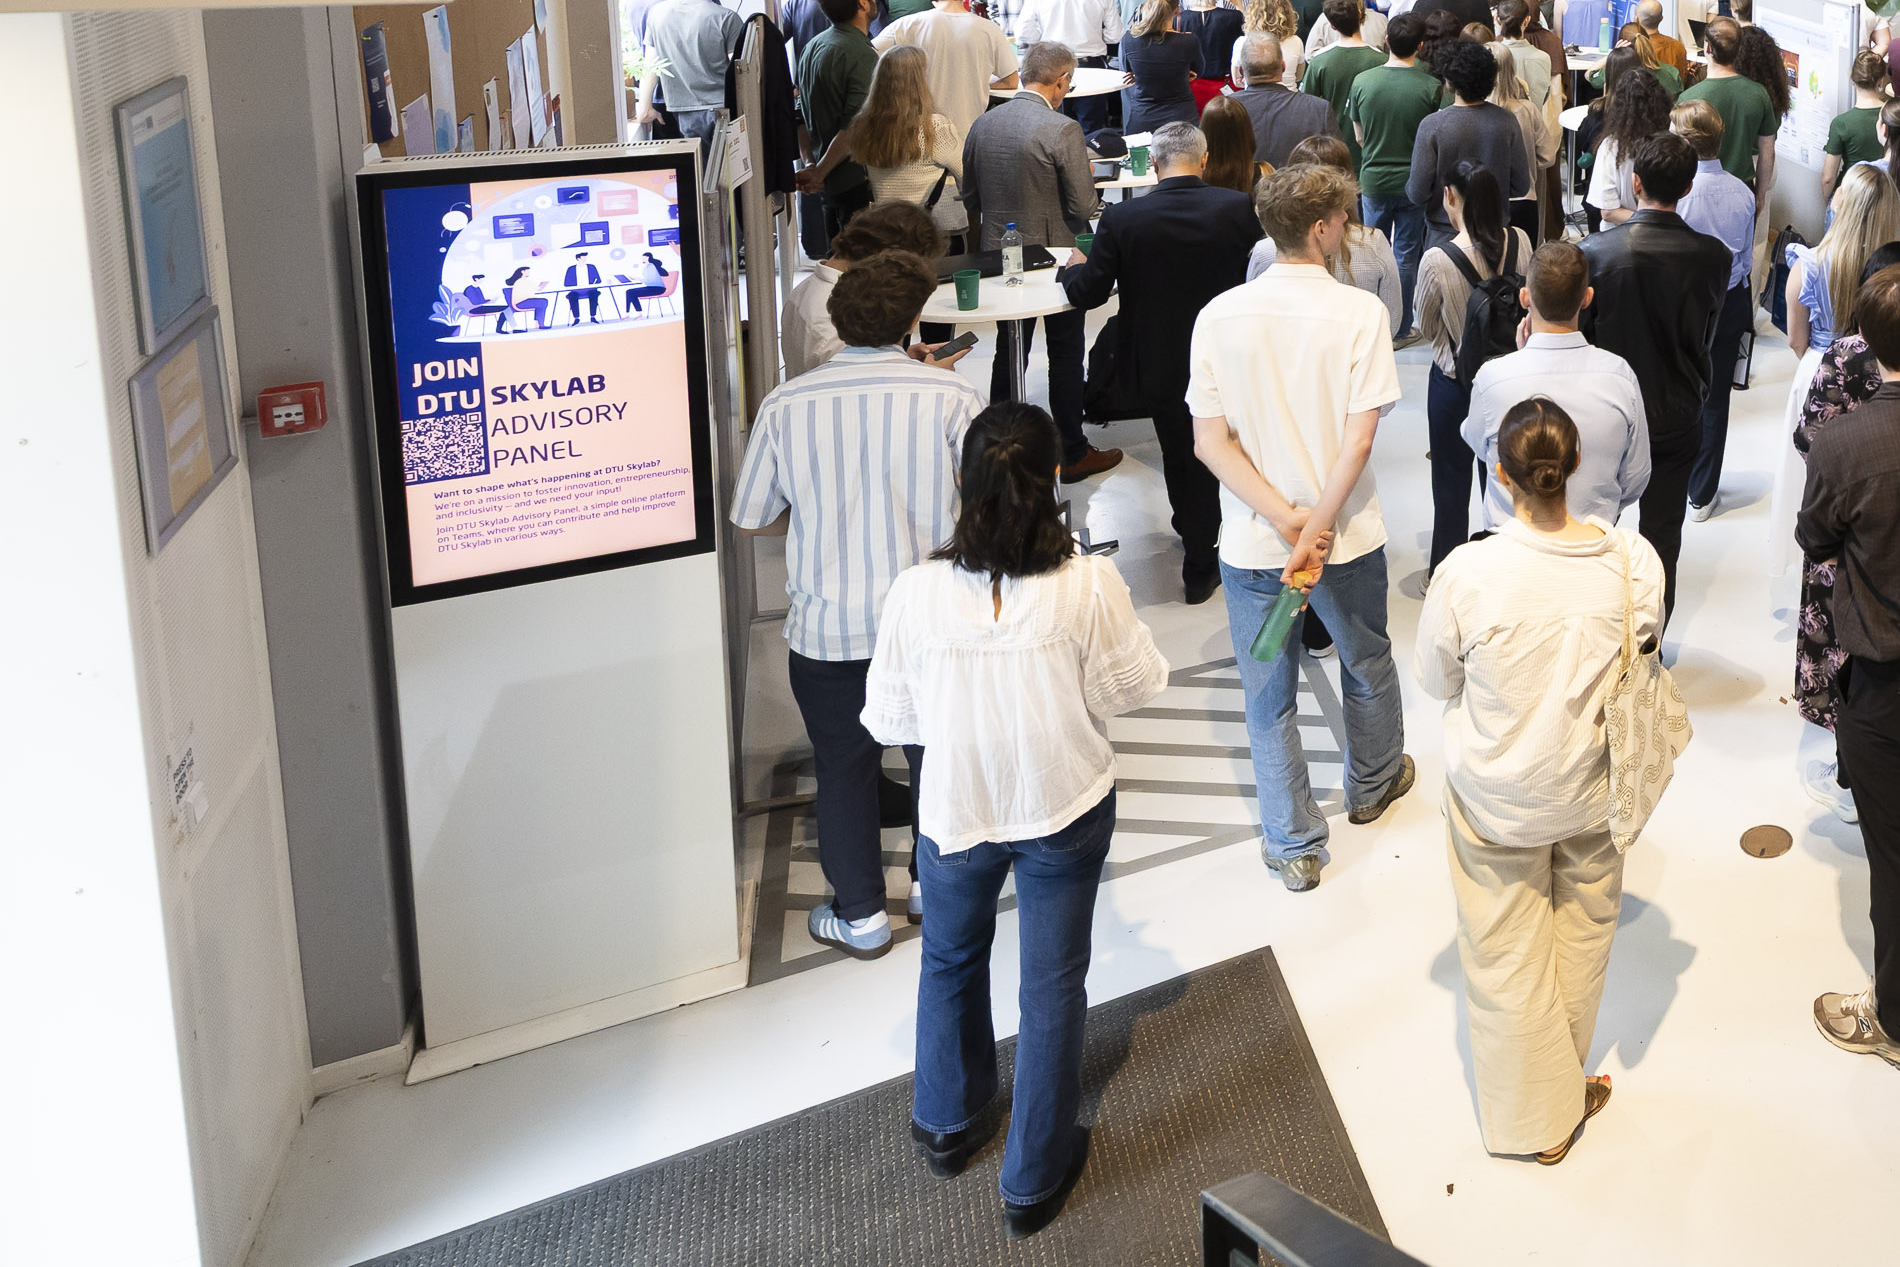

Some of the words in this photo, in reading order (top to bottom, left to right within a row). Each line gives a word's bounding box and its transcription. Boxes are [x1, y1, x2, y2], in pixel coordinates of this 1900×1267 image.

[412, 357, 479, 387] JOIN
[417, 388, 481, 415] DTU
[491, 374, 606, 405] SKYLAB
[491, 402, 628, 437] ADVISORY
[493, 440, 582, 469] PANEL
[434, 490, 460, 499] Want
[475, 483, 504, 494] shape
[541, 471, 591, 483] happening
[605, 465, 624, 474] DTU
[626, 460, 661, 471] Skylab?
[463, 499, 475, 507] on
[486, 493, 521, 503] mission
[536, 486, 562, 495] foster
[435, 511, 453, 520] and
[456, 504, 503, 517] inclusivity
[514, 499, 531, 508] and
[550, 492, 572, 502] need
[575, 490, 593, 500] your
[596, 485, 622, 496] input!
[437, 526, 454, 535] Join
[457, 522, 477, 531] DTU
[479, 517, 510, 528] Skylab
[512, 511, 552, 522] Advisory
[590, 500, 619, 510] simple
[621, 495, 647, 506] online
[649, 490, 686, 502] platform
[487, 526, 516, 535] where
[518, 523, 535, 532] you
[556, 512, 601, 524] contribute
[603, 508, 619, 517] and
[621, 505, 640, 515] help
[642, 500, 676, 511] improve
[438, 544, 458, 553] DTU
[460, 539, 492, 550] Skylab
[505, 531, 538, 542] various
[540, 527, 566, 537] ways.
